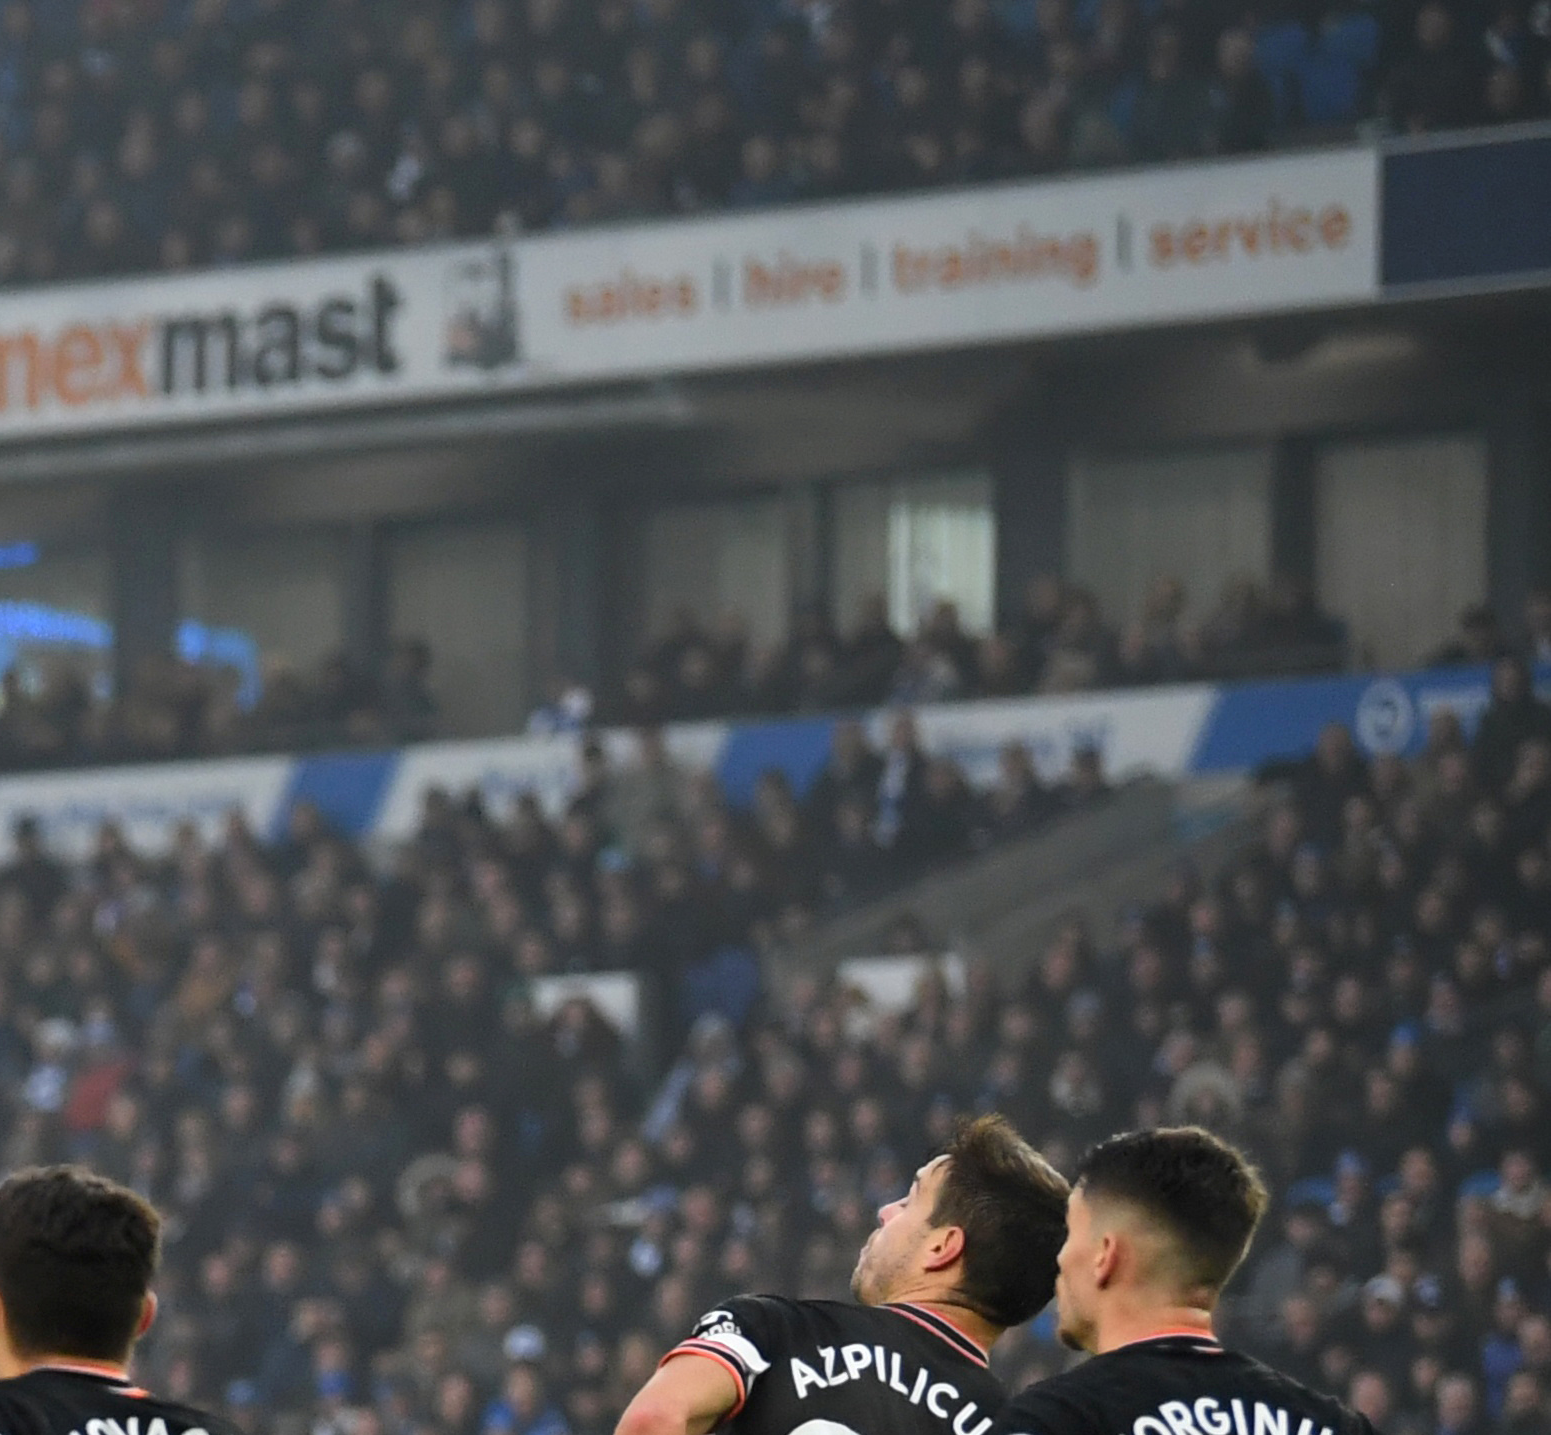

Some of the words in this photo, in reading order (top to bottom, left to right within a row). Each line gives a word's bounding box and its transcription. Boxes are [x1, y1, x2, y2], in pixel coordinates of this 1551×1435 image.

[563, 264, 695, 330] sales
[744, 251, 845, 308] hire
[892, 223, 1097, 292] training
[1149, 195, 1352, 269] service
